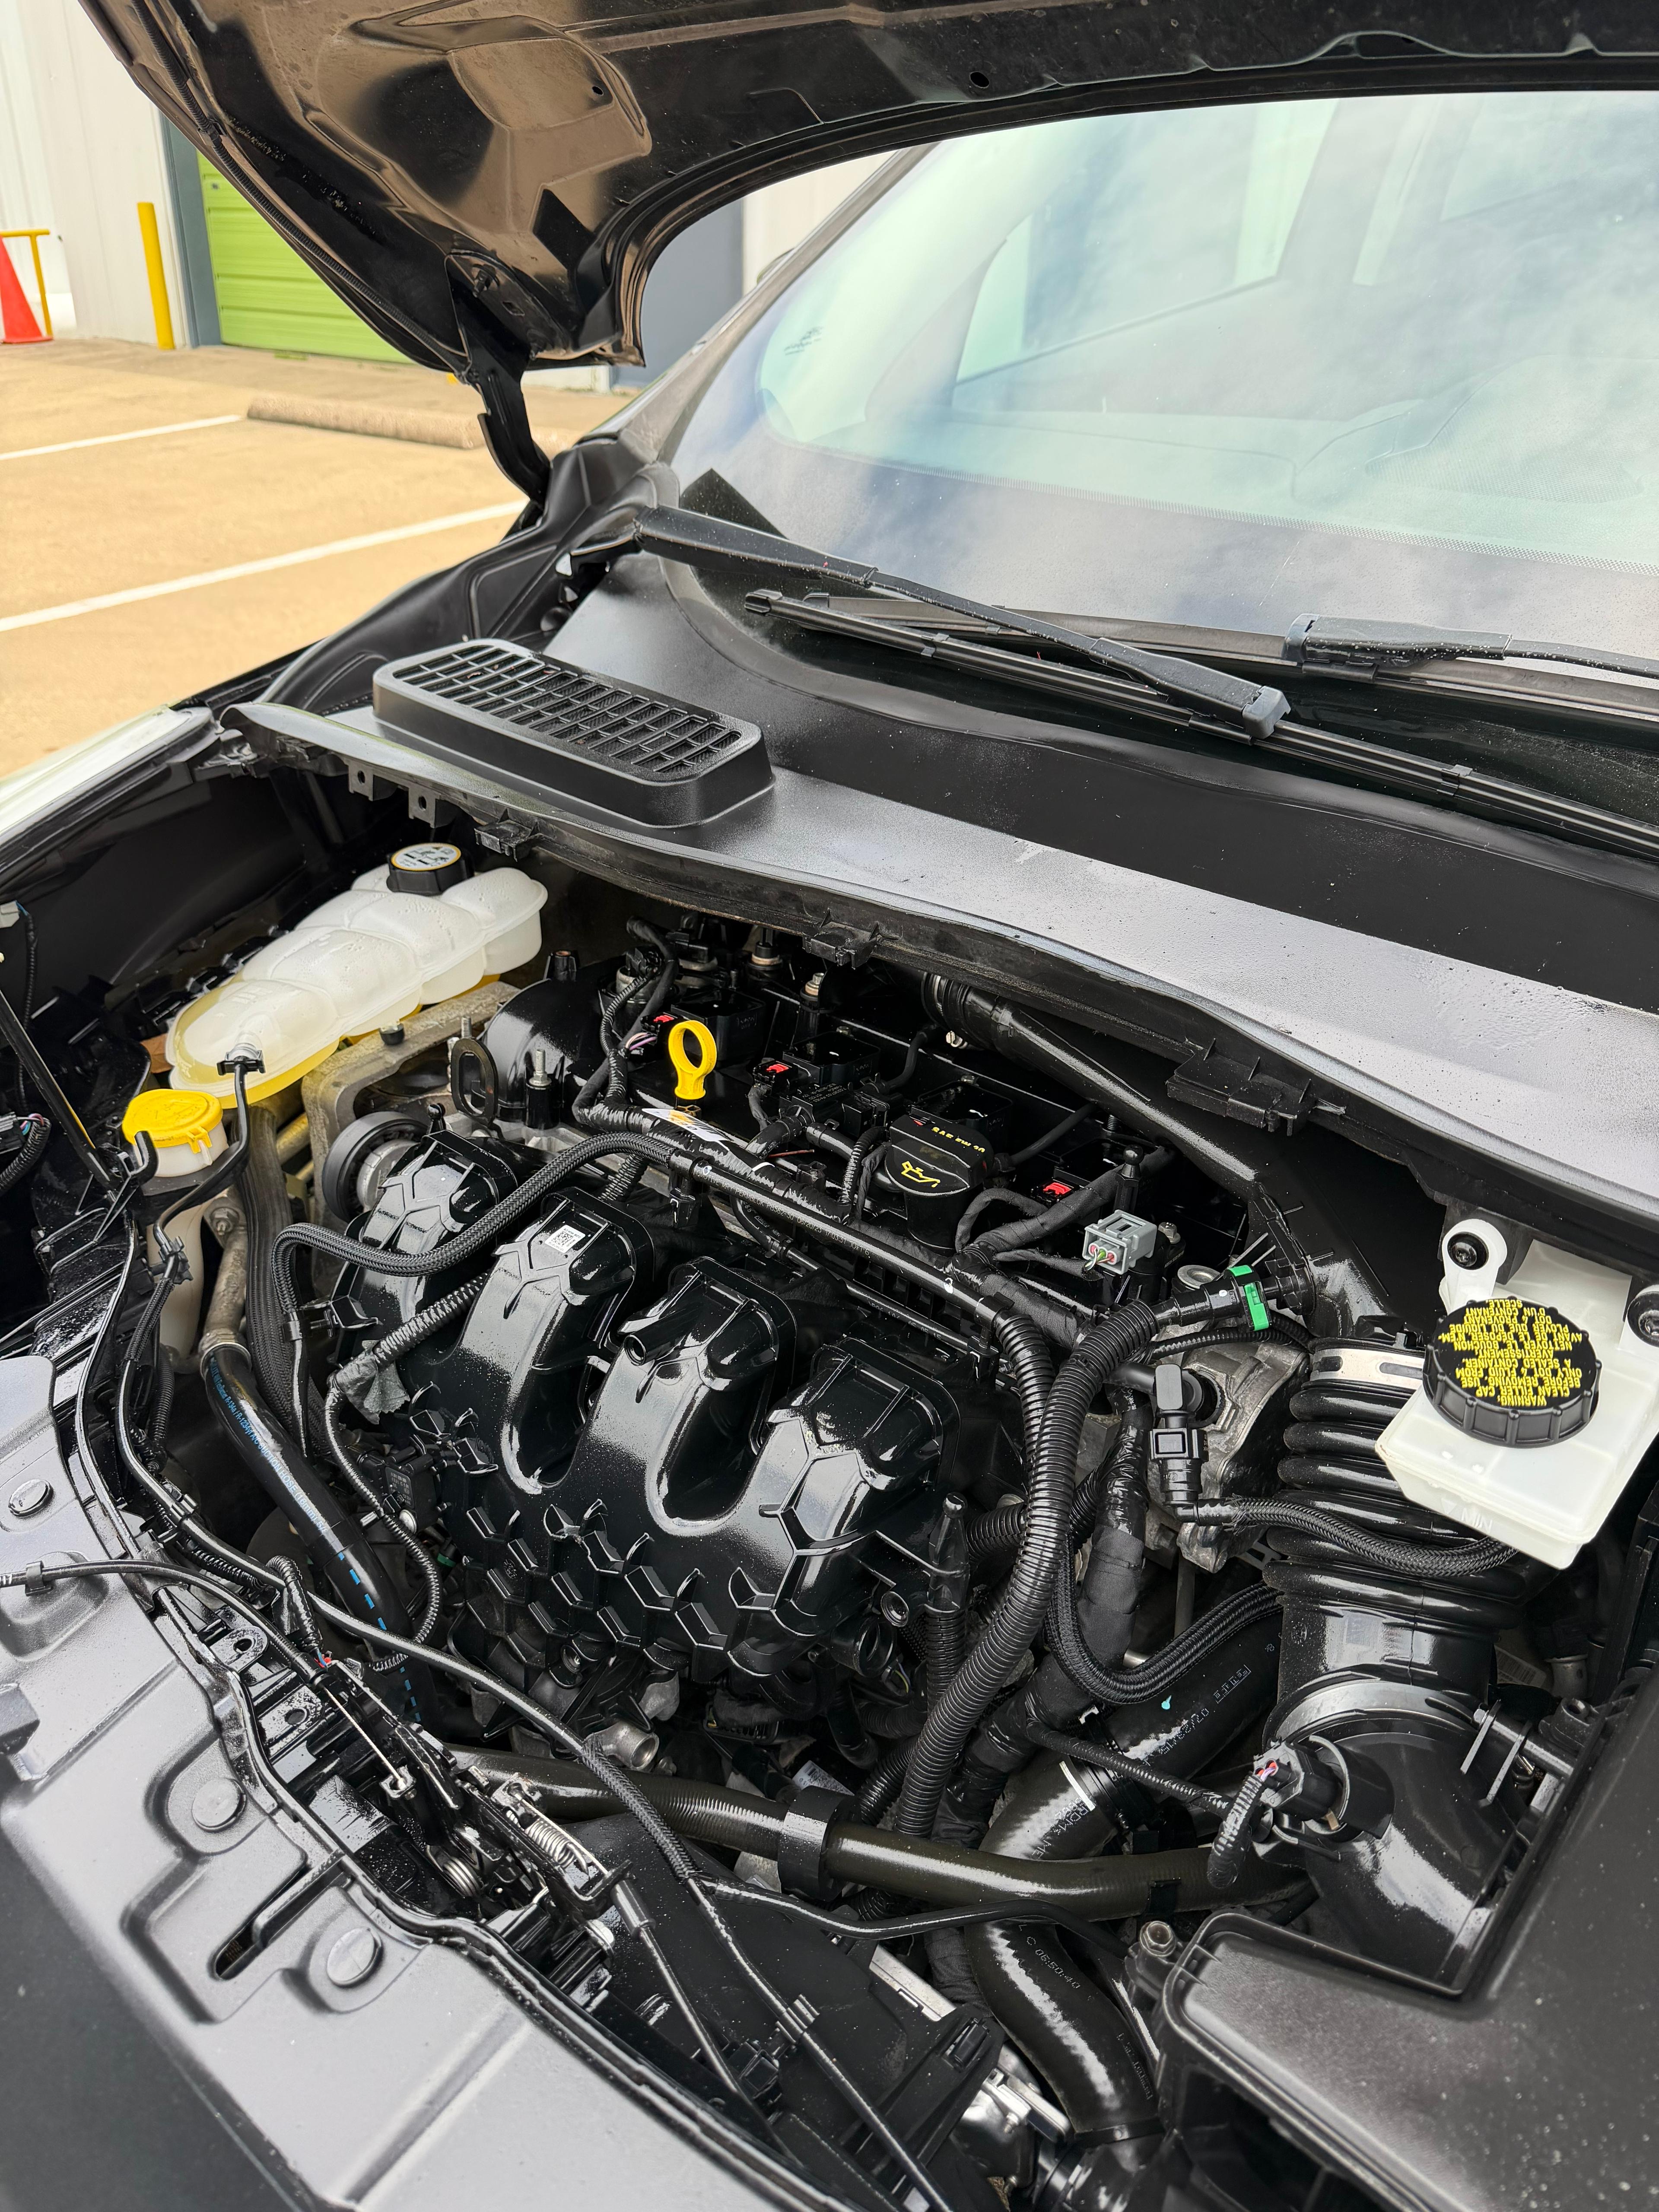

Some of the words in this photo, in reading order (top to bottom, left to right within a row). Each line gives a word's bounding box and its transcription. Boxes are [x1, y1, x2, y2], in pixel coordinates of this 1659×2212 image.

[1465, 1307, 1518, 1316] CONTENANT
[1523, 1307, 1545, 1317] D'UN
[1464, 1316, 1517, 1325] PROVENANT
[1522, 1316, 1528, 1324] 4
[1535, 1316, 1552, 1324] DOT
[1449, 1324, 1487, 1333] LIQUIDE
[1491, 1324, 1504, 1333] DU
[1509, 1324, 1528, 1333] QUE
[1532, 1324, 1569, 1333] PLOYER
[1518, 1332, 1530, 1342] LE
[1534, 1332, 1548, 1341] DE
[1553, 1333, 1582, 1342] AVANT
[1454, 1341, 1499, 1351] BOUCHON
[1506, 1341, 1518, 1350] LE
[1523, 1341, 1572, 1351] NETTOYER
[1462, 1358, 1518, 1369] CONTAINER.
[1523, 1358, 1560, 1369] SEALED
[1564, 1359, 1571, 1368] A
[1456, 1368, 1484, 1379] FROM
[1488, 1367, 1516, 1377] FLUID
[1520, 1367, 1527, 1376] 4
[1534, 1368, 1551, 1377] DOT
[1557, 1368, 1582, 1378] ONLY
[1461, 1377, 1480, 1388] USE
[1543, 1377, 1581, 1388] BEFORE
[1476, 1386, 1495, 1397] CAP
[1500, 1386, 1533, 1396] FILLER
[1538, 1386, 1570, 1397] CLEAN
[225, 1395, 237, 1413] R-134a
[250, 1431, 261, 1445] A/C
[258, 1442, 281, 1472] SUCTION
[278, 1470, 298, 1493] HOSE
